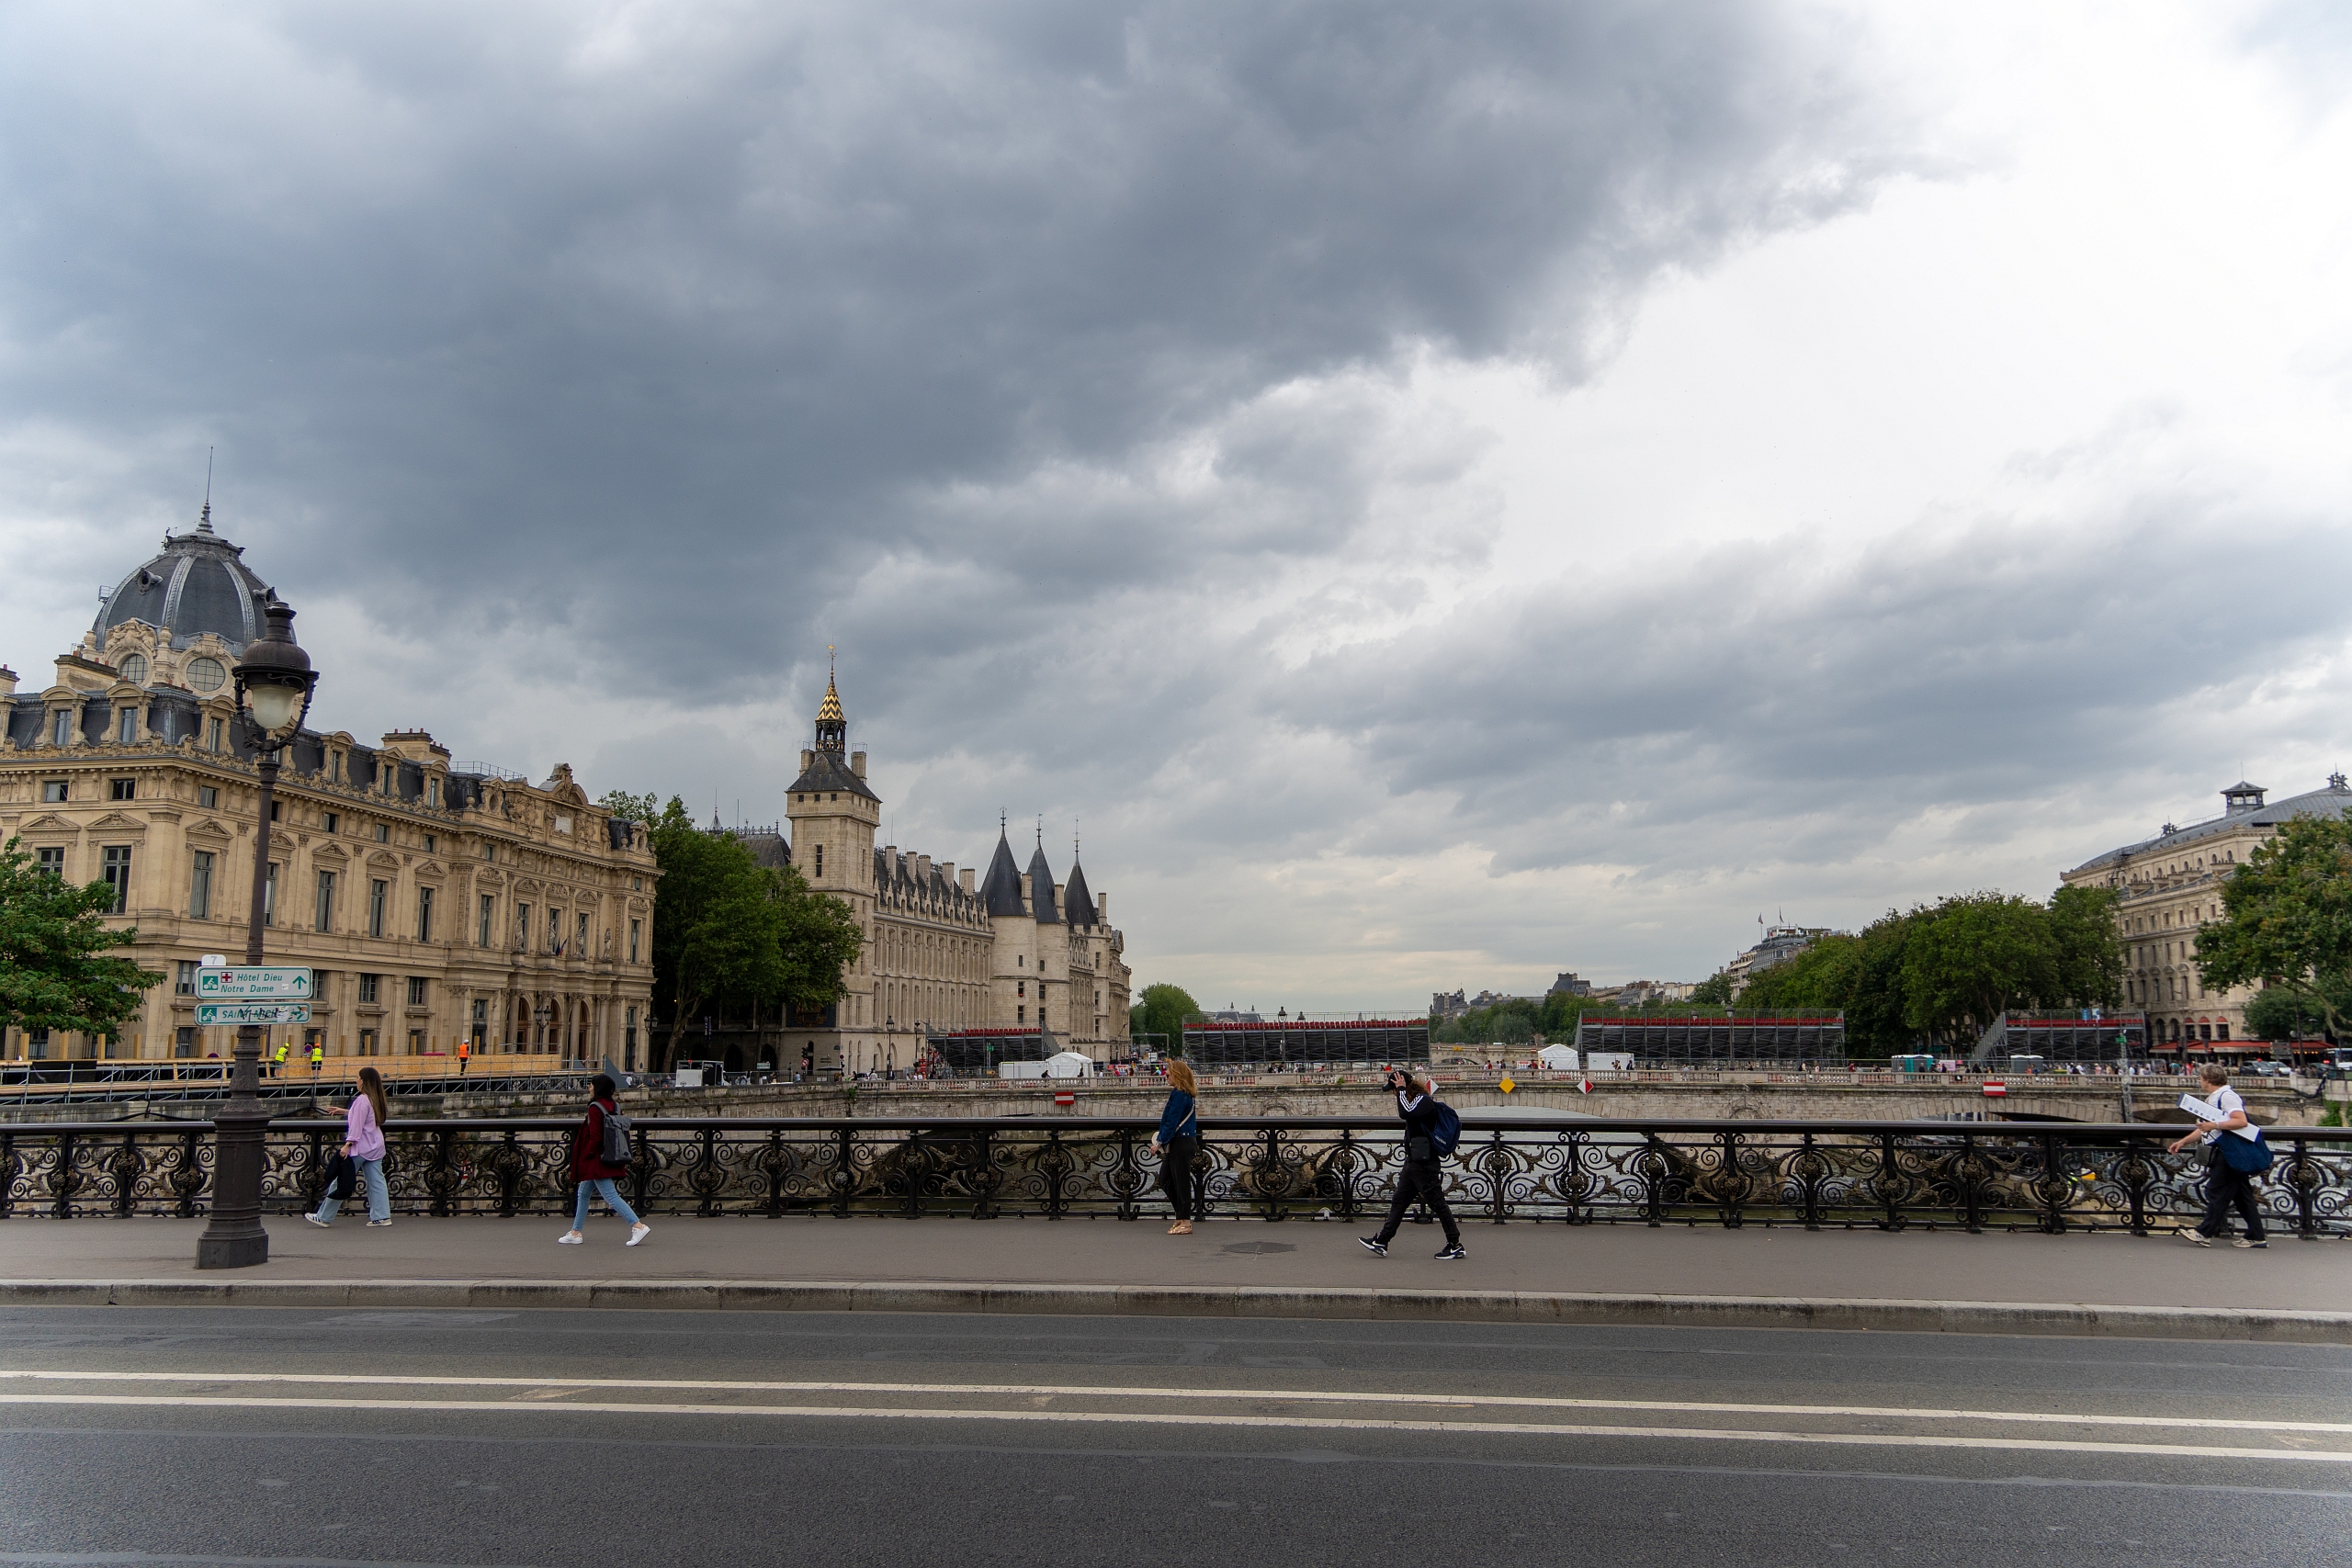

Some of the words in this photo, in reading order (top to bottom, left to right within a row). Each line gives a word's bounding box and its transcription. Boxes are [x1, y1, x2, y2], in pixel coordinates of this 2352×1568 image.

[210, 955, 218, 965] 7
[237, 973, 260, 982] Hôtel
[264, 973, 283, 982] Dieu
[220, 985, 244, 993] Notre
[250, 985, 274, 993] Dame
